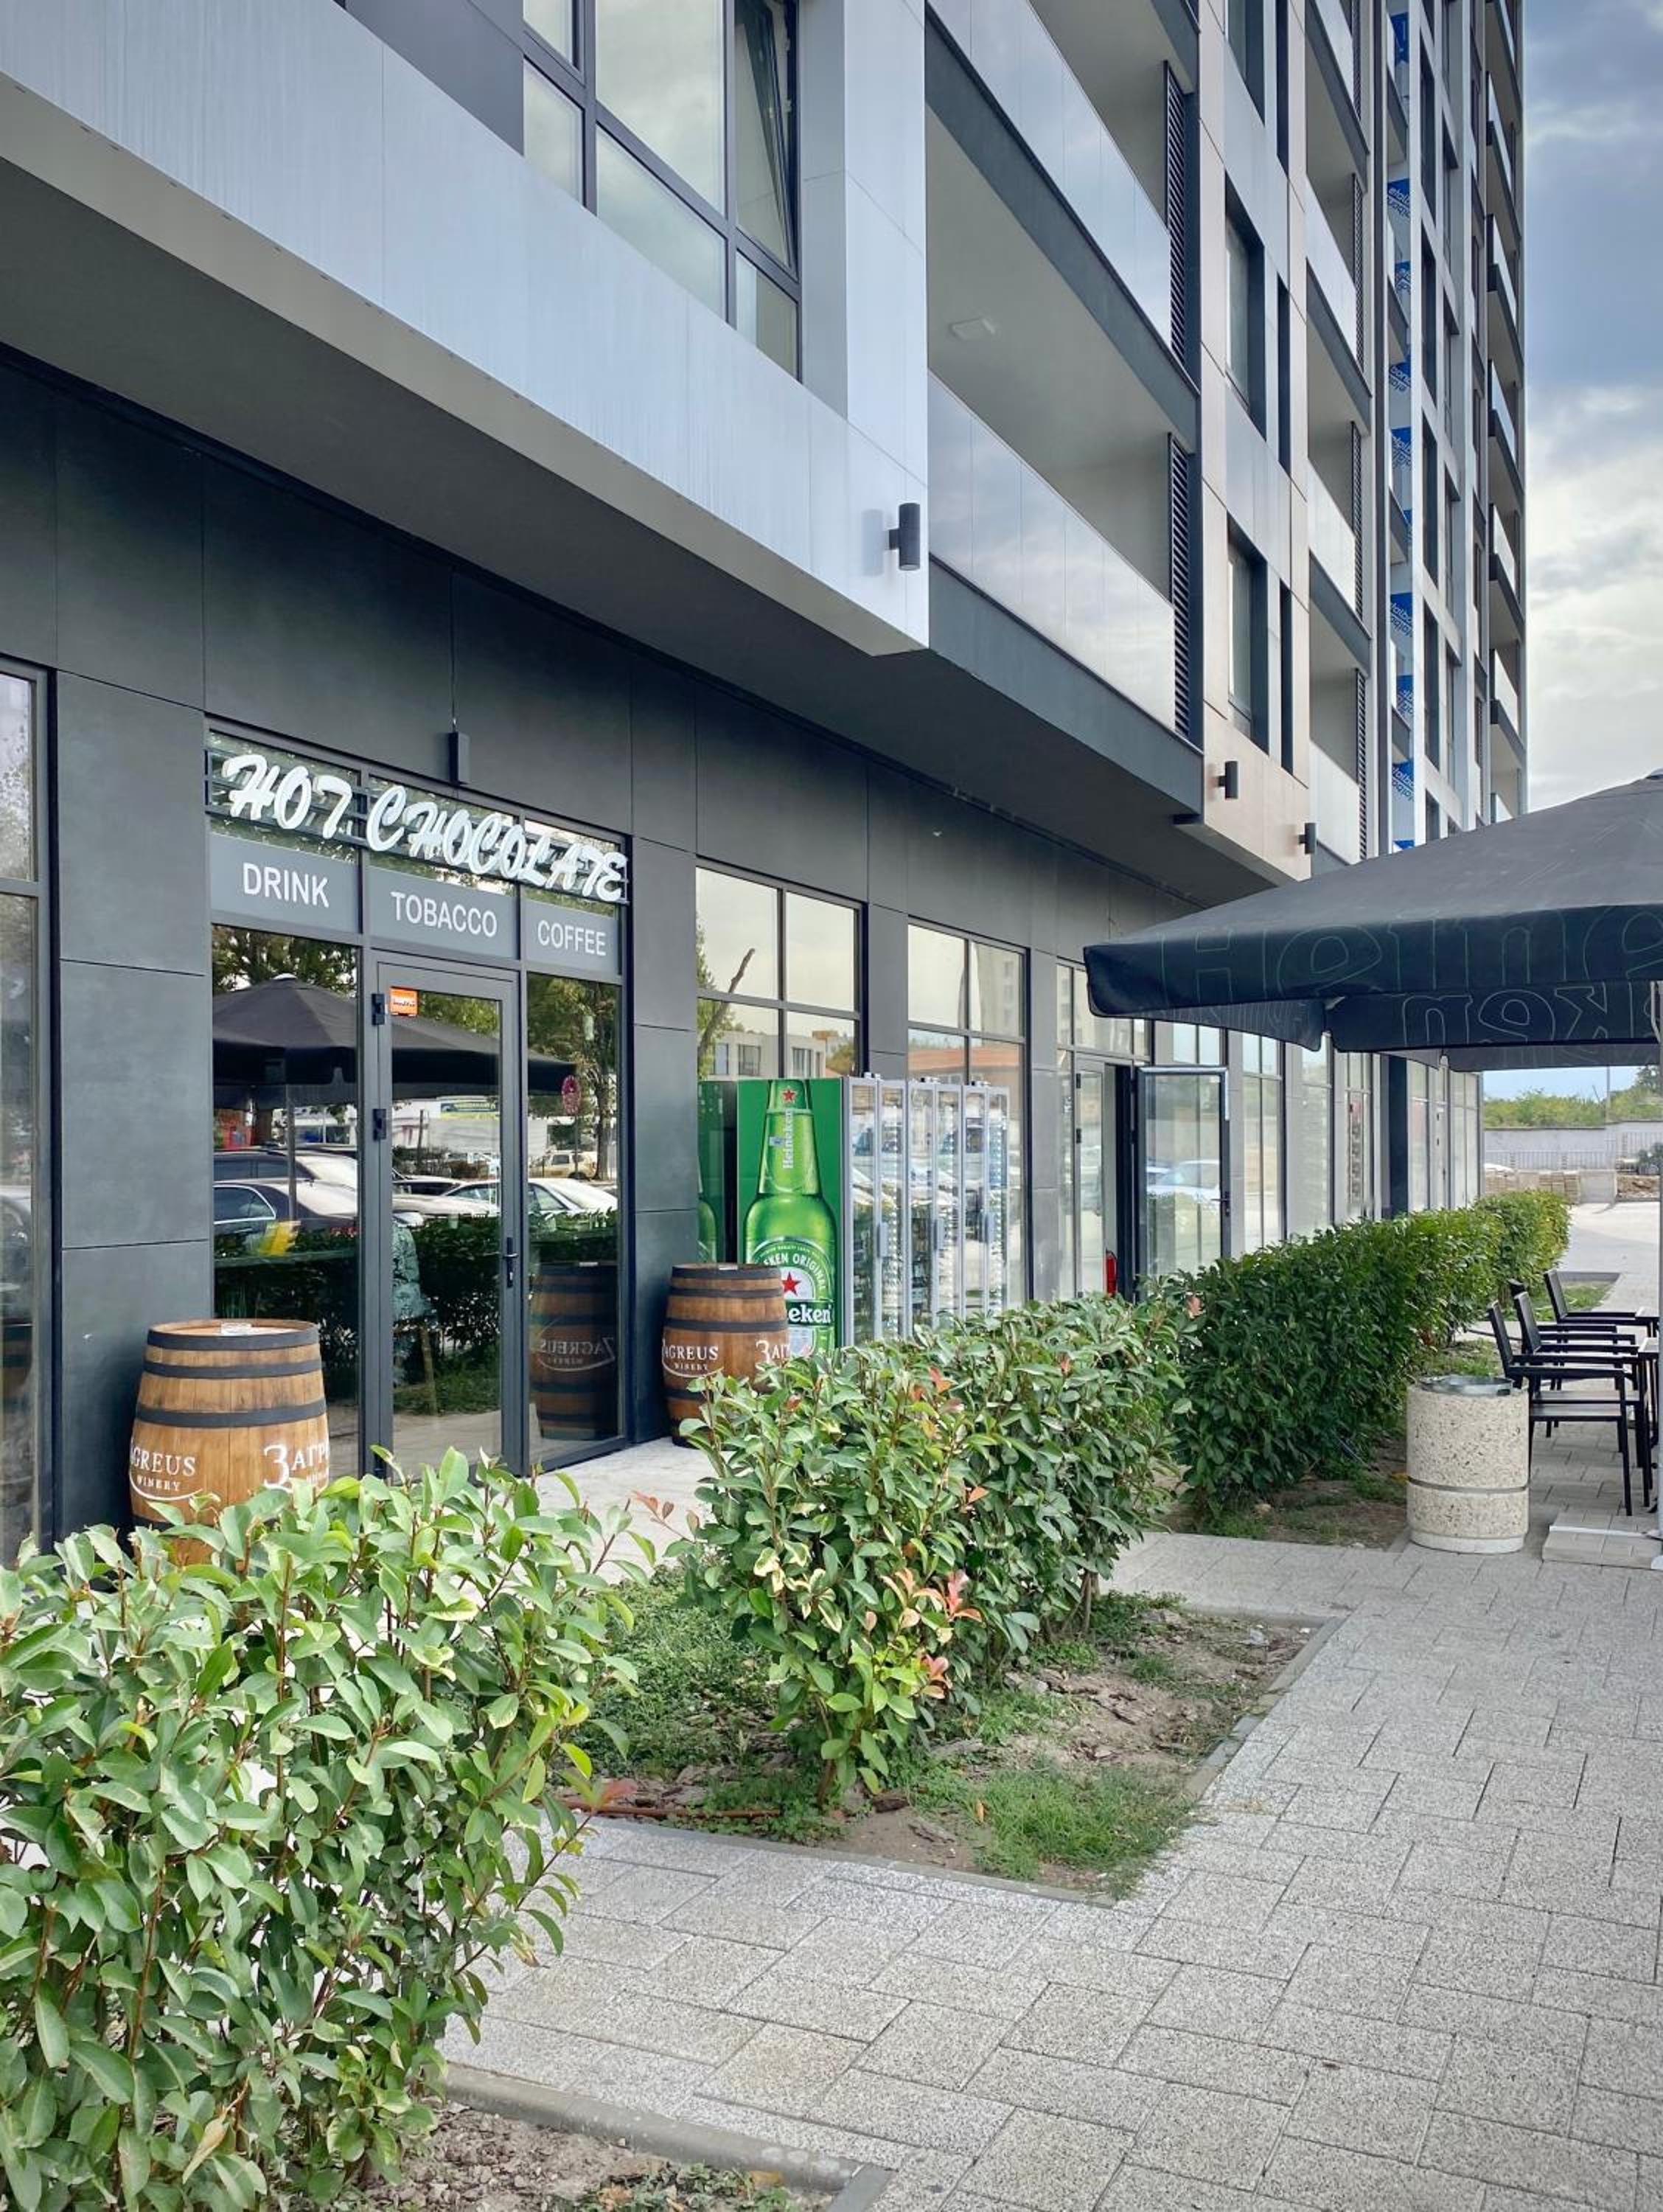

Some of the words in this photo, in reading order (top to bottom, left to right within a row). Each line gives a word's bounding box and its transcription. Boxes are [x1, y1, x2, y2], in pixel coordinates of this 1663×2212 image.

[222, 754, 353, 839] HOT
[366, 785, 630, 902] CHOCOLATE
[242, 862, 330, 909] DRINK
[390, 891, 498, 939] TOBACCO
[537, 919, 607, 957] COFFEE
[136, 1475, 181, 1492] WINERY
